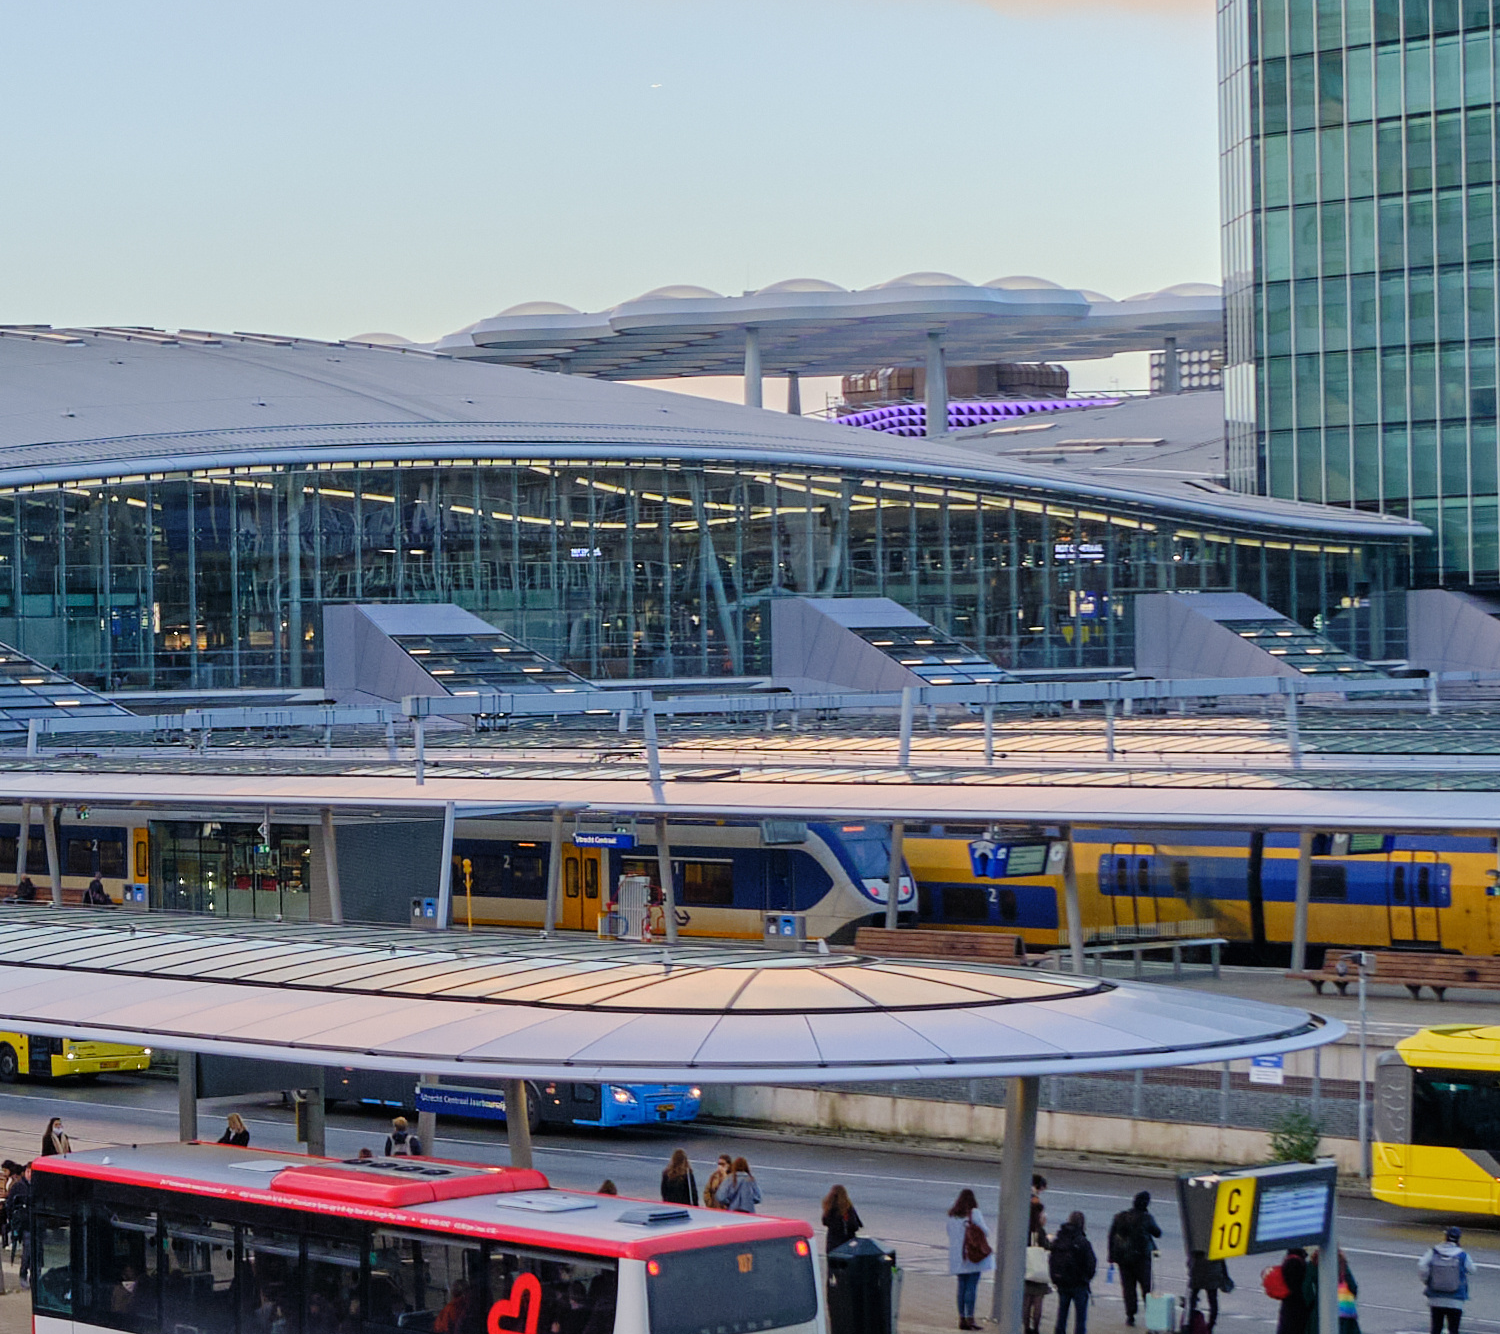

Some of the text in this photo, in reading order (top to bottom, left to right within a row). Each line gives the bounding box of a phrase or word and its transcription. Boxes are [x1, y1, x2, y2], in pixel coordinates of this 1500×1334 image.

[91, 839, 98, 851] 2
[503, 855, 511, 868] 2
[988, 888, 997, 902] 2
[420, 1093, 443, 1102] Utrecht
[444, 1095, 469, 1105] Centraal
[1228, 1188, 1240, 1216] C
[1217, 1221, 1242, 1252] 10
